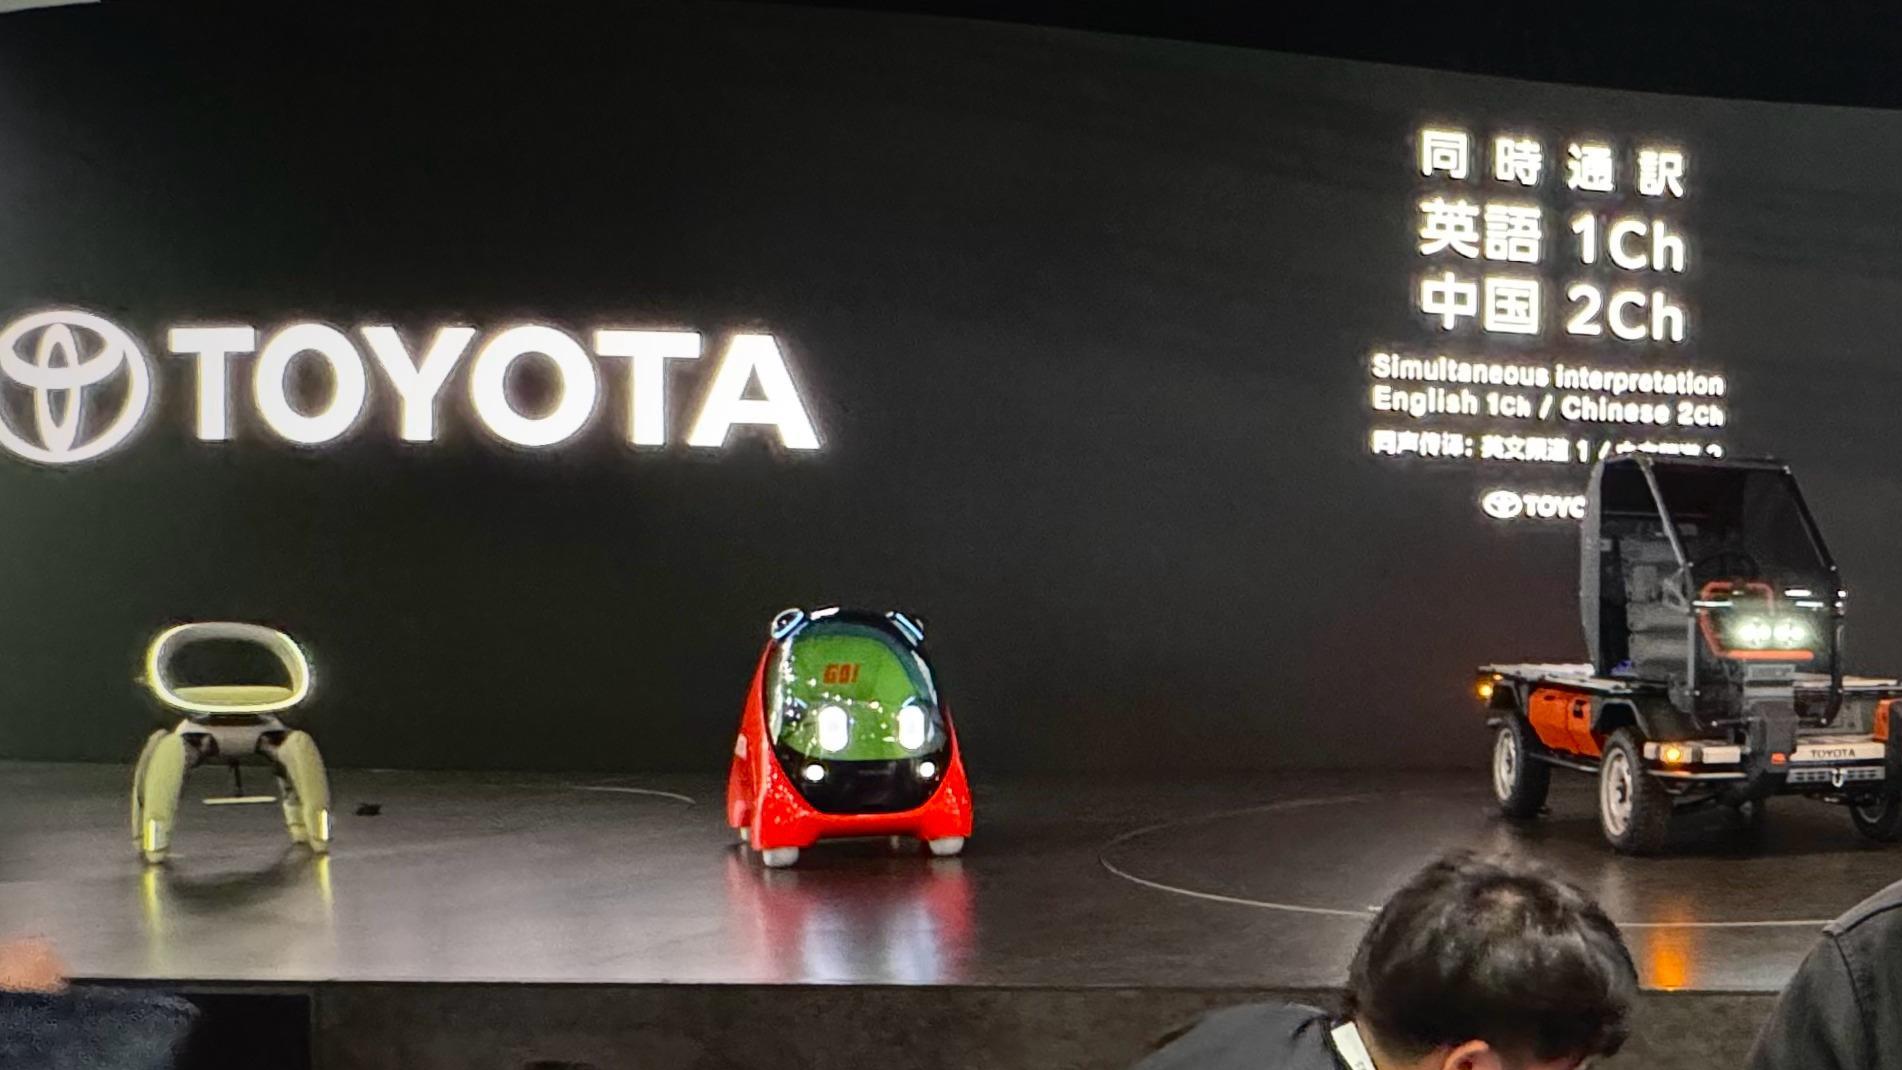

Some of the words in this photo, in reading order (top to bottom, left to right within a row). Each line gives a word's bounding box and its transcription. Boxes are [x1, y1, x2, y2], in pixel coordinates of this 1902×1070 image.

[1420, 128, 1686, 199] 同時通訳
[1419, 198, 1543, 264] 英語
[1571, 213, 1685, 273] 1Ch
[1420, 271, 1542, 335] 中国
[1566, 283, 1685, 343] 2Ch
[168, 321, 825, 451] TOYOTA
[1371, 352, 1550, 388] Simultaneous
[1371, 384, 1478, 418] English
[1561, 394, 1670, 425] Chinese
[1522, 494, 1586, 519] TOYO
[1811, 748, 1856, 759] TOYOTA
